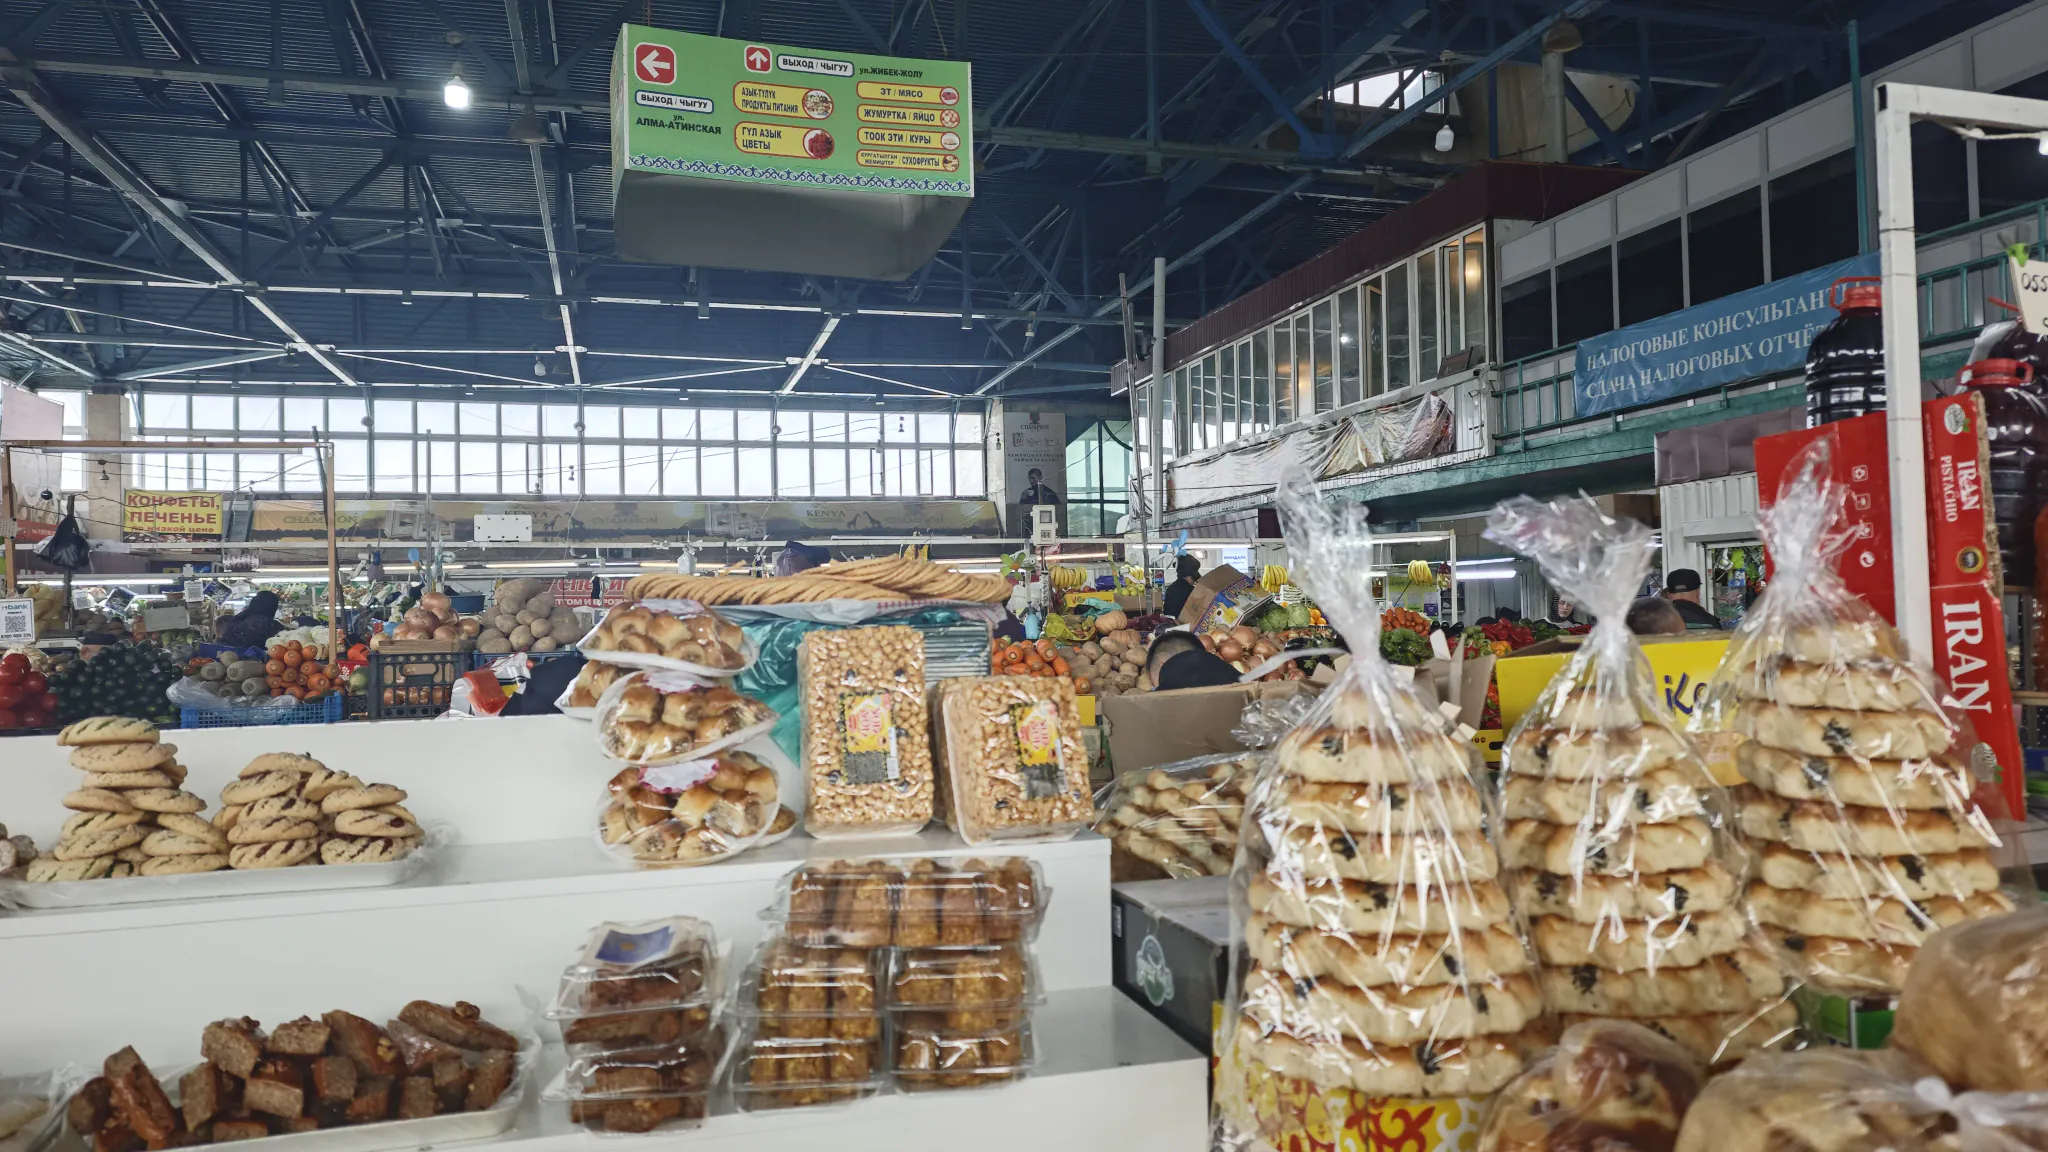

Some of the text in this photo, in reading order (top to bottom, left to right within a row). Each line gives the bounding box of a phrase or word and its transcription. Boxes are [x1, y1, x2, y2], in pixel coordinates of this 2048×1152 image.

[782, 58, 814, 69] ВЫХОД
[820, 63, 848, 72] ЧЫГУУ
[859, 67, 923, 78] ул.ЖИБЕК-ЖОЛУ
[880, 87, 891, 96] ЭТ
[898, 89, 923, 98] МЯСО
[640, 93, 674, 106] ВЫХОД
[680, 98, 708, 109] ЧЫГУУ
[741, 98, 799, 114] ПРОДУКТЫ ПИТАНИЯ
[673, 114, 685, 122] ул.
[863, 108, 907, 120] ЖУМУРТКА
[913, 111, 935, 122] ЯЙЦО
[636, 117, 722, 135] АЛМА-АТИНСКАЯ
[759, 129, 782, 139] АЗЫК
[864, 131, 886, 141] ТООК
[887, 133, 903, 142] ЭТИ
[909, 134, 931, 144] КУРЫ
[742, 139, 770, 150] ЦВЕТЫ
[902, 156, 940, 167] СУХОФРУКТЫ
[1586, 327, 1689, 372] НАЛОГОВЫЕ
[1586, 372, 1636, 400] СДАЧА
[1640, 342, 1754, 387] НАЛОГОВЫХ
[1940, 455, 1958, 523] PISTACHIO
[1957, 459, 1980, 511] IRAN
[127, 495, 220, 510] КОНФЕТЫ,
[129, 511, 217, 524] ПЕЧЕНЬЕ
[283, 514, 357, 524] CHAMON
[806, 509, 846, 518] KENYA
[147, 525, 186, 533] низкой
[1942, 600, 1992, 713] IRAN
